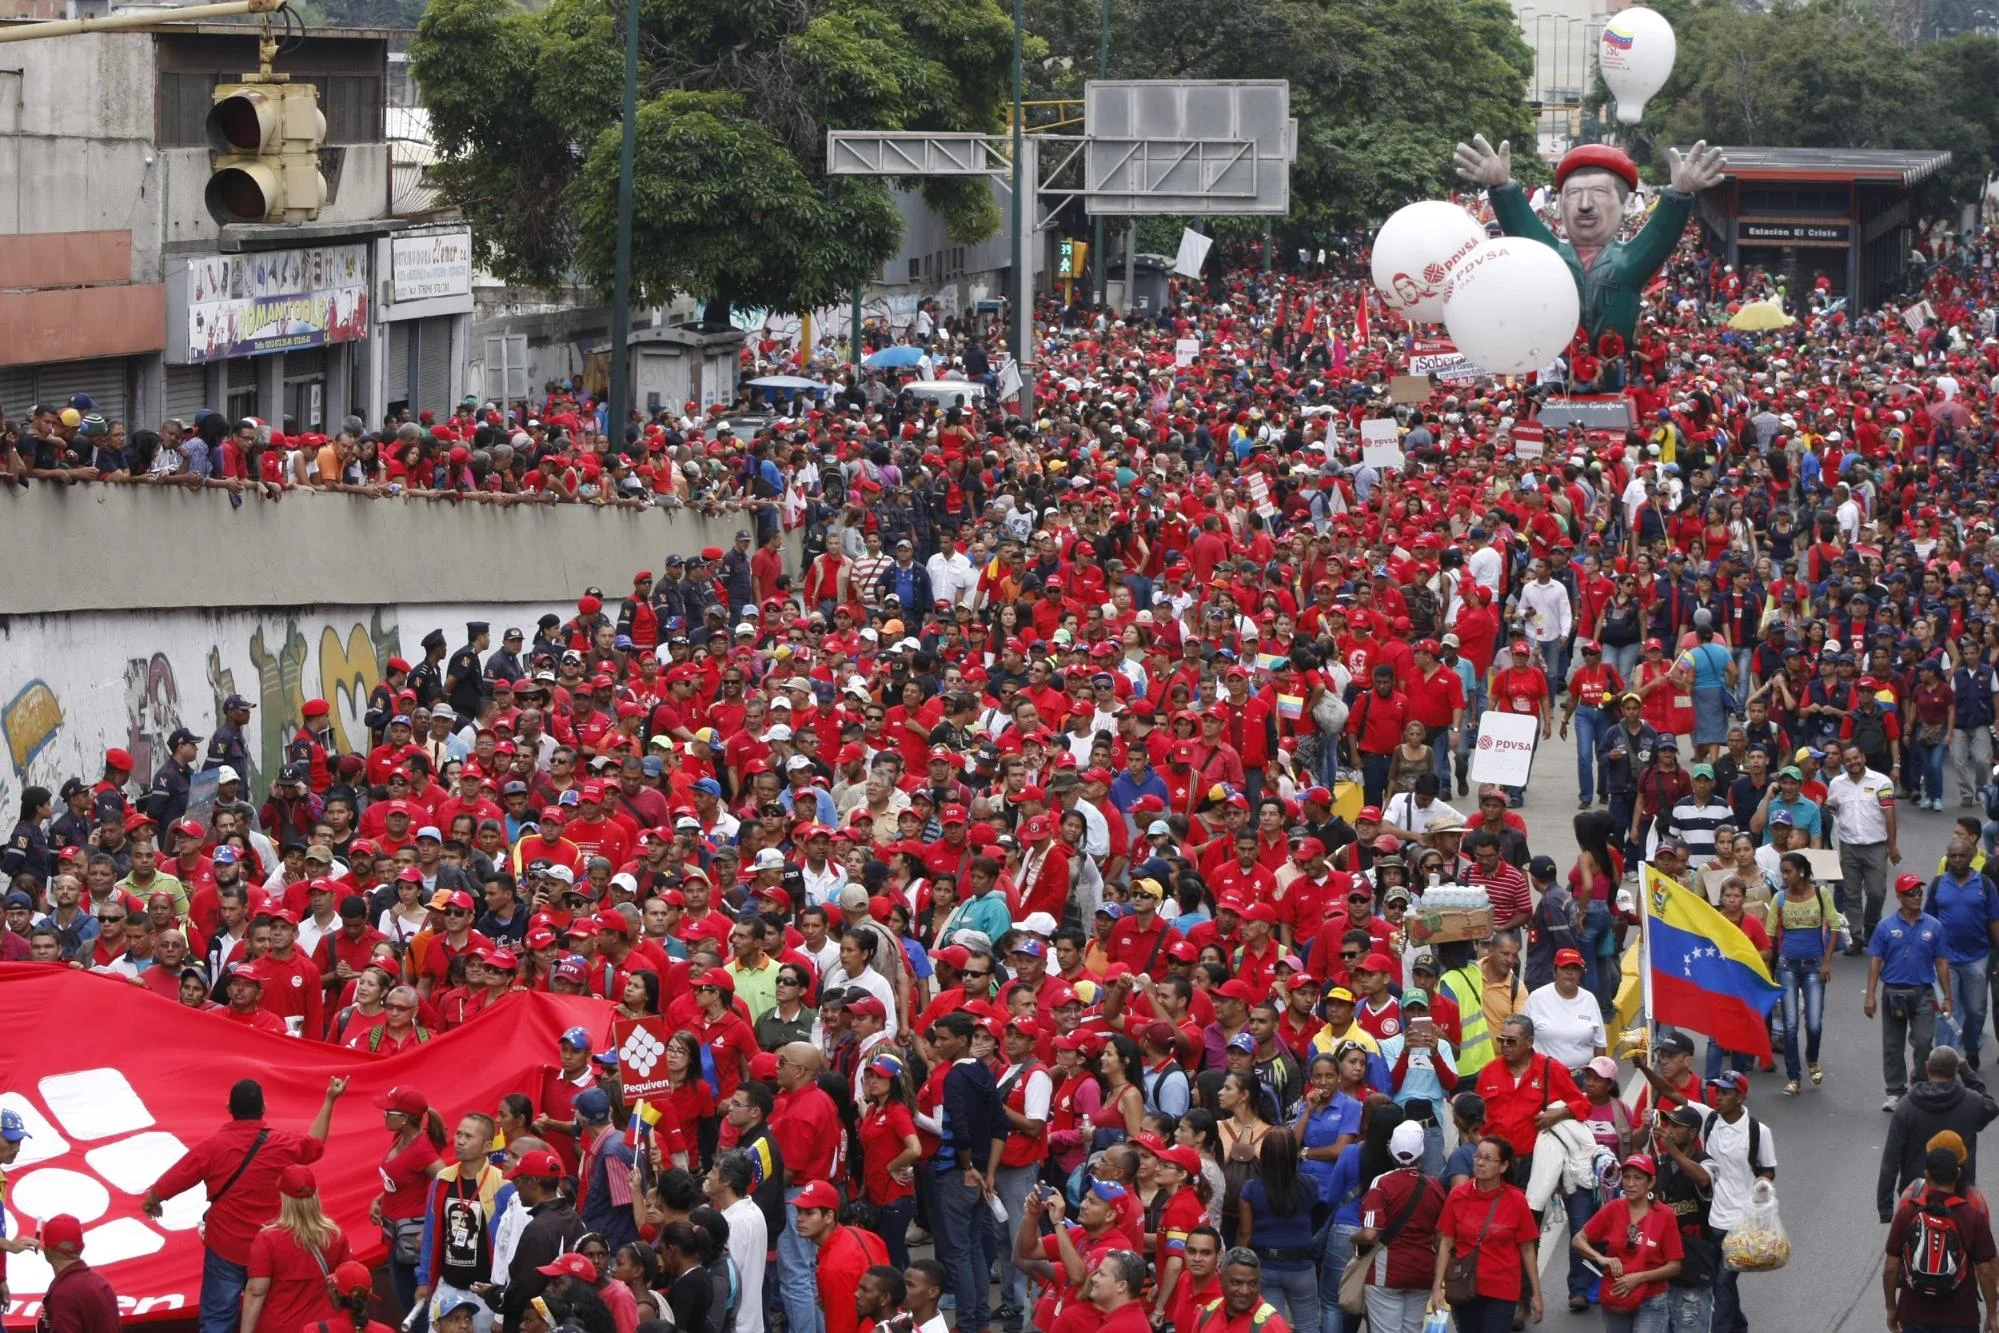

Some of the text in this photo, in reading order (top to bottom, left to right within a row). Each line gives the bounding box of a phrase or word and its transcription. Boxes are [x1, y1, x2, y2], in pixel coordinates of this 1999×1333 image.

[1808, 229, 1837, 237] Cristo
[1444, 237, 1479, 271] PDVSA
[1456, 248, 1510, 281] PDVSA
[1496, 740, 1531, 752] PDVSA
[623, 1079, 670, 1094] Pequiven
